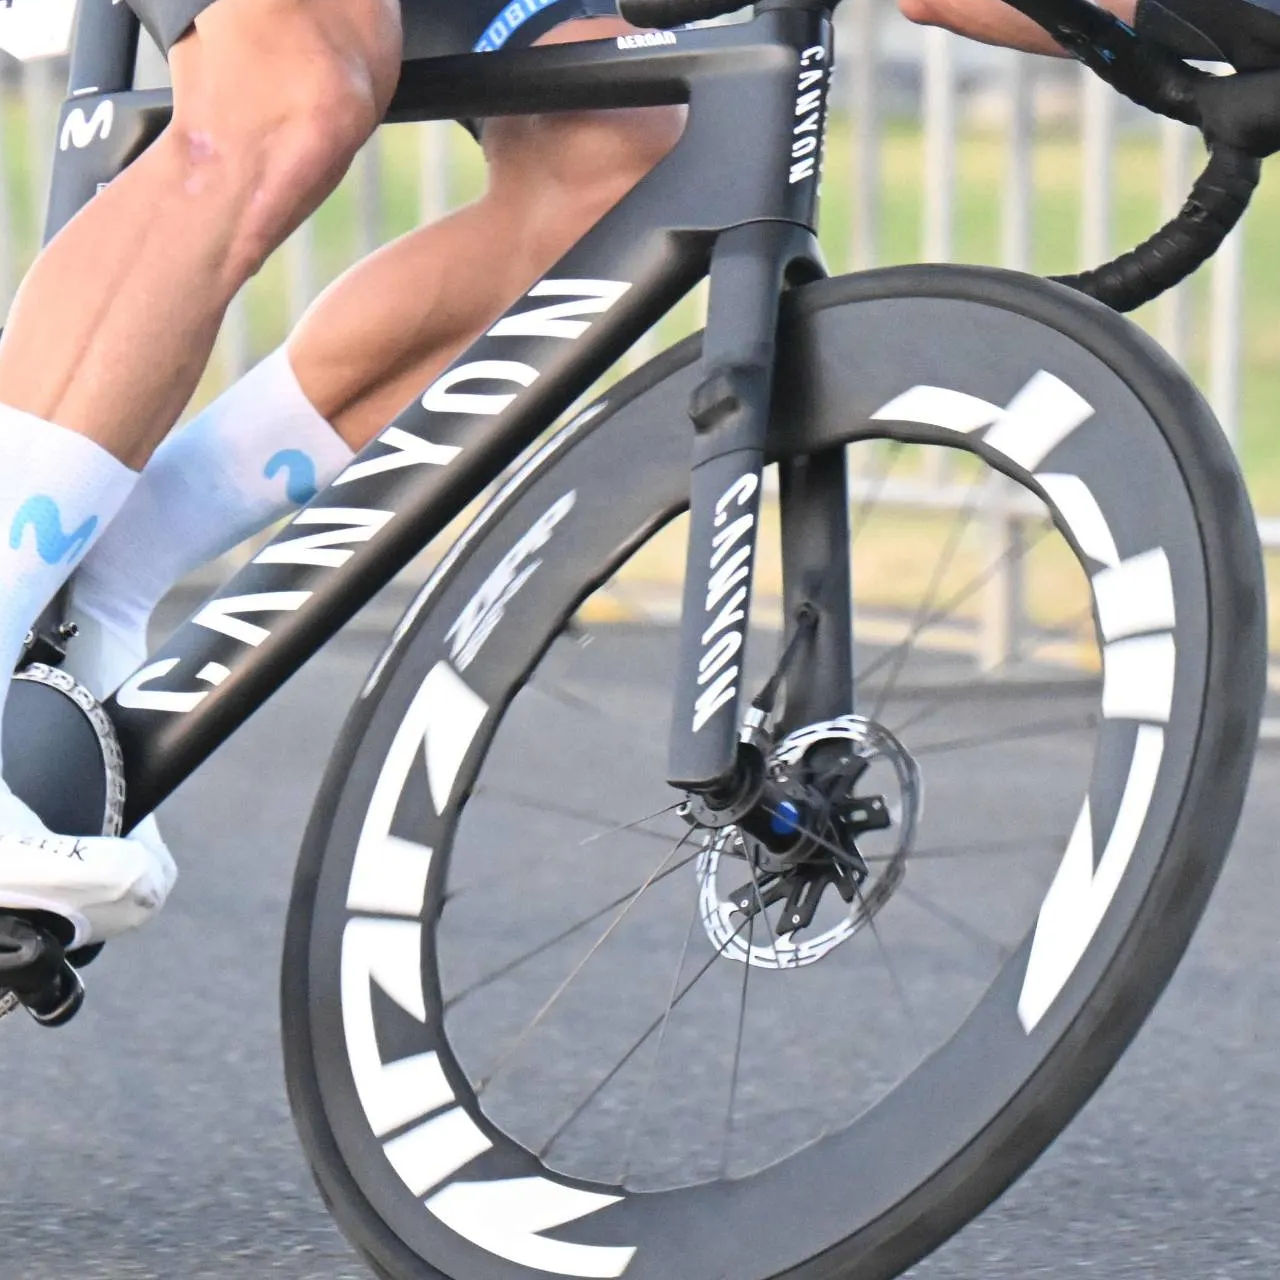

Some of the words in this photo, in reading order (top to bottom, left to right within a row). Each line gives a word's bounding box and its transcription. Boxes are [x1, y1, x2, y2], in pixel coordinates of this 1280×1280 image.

[789, 45, 825, 184] CANYON
[116, 280, 634, 714] CANYON
[692, 472, 759, 732] CANYON
[869, 369, 1176, 1034] ZIPP
[340, 659, 639, 1278] ZIPP
